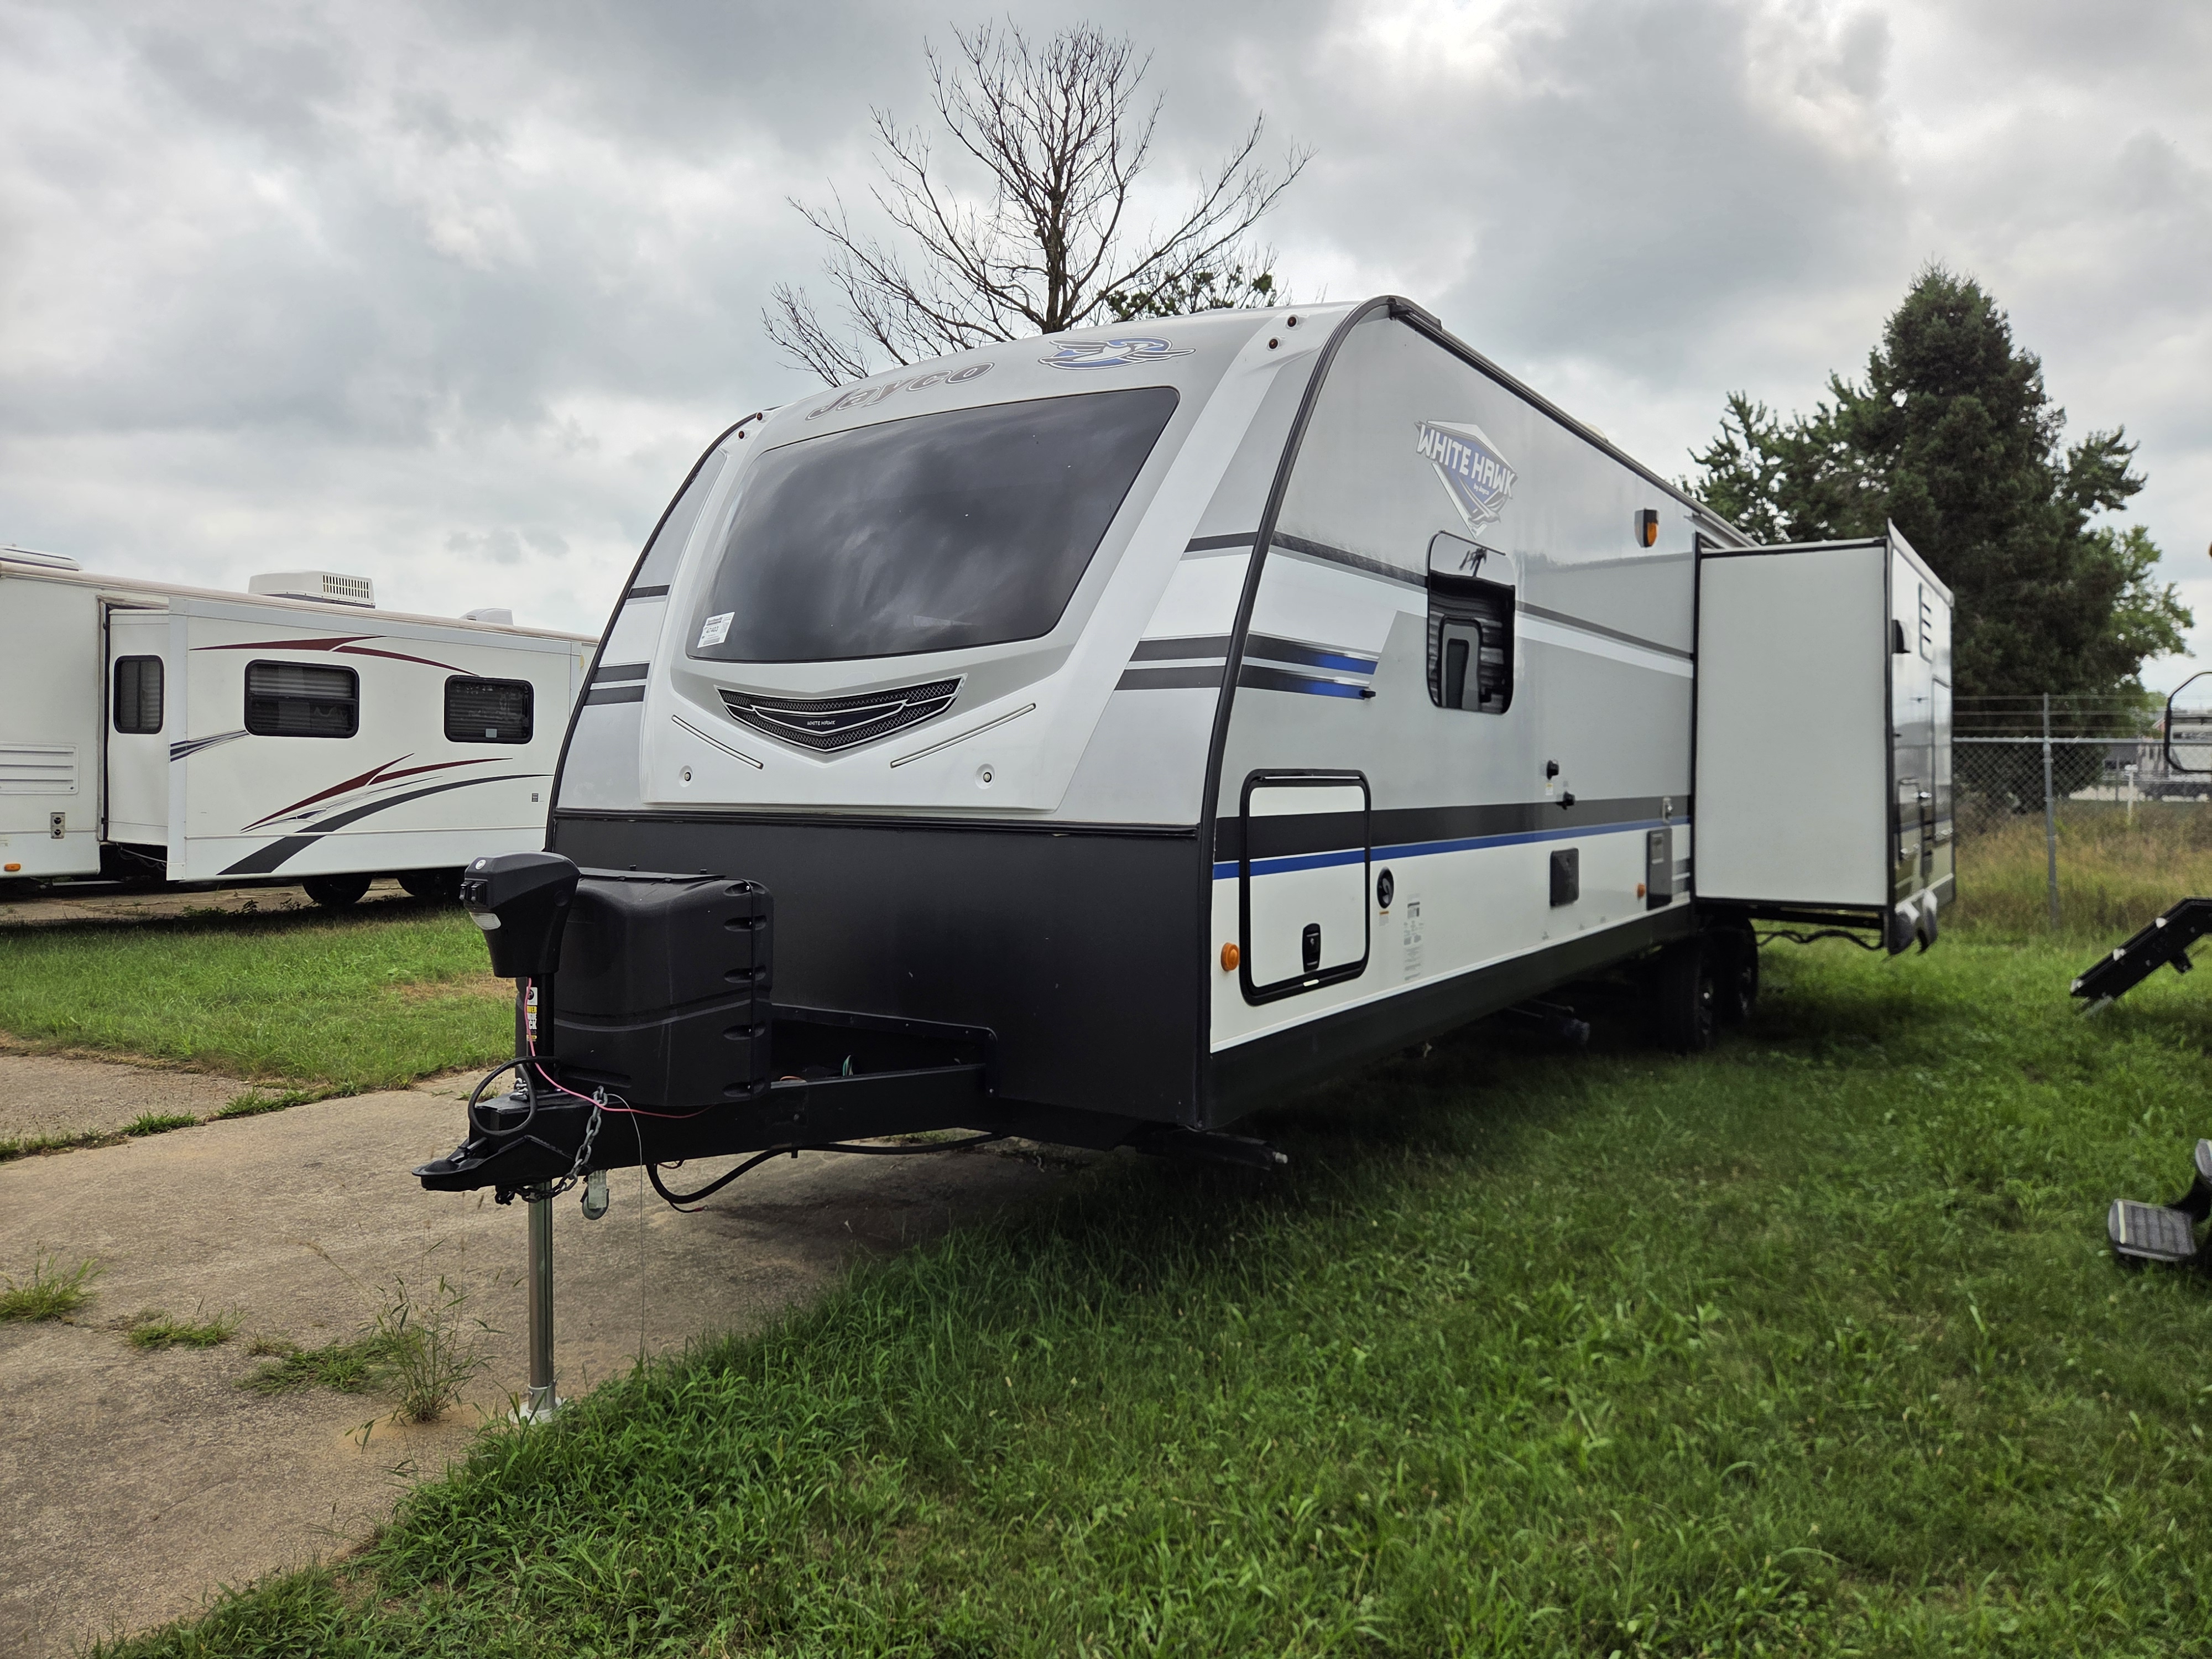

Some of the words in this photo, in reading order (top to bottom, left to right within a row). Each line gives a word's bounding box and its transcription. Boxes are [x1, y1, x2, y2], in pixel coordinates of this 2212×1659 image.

[805, 362, 995, 421] Jayco
[1416, 424, 1472, 476] WHITE
[1471, 452, 1516, 497] HAWK
